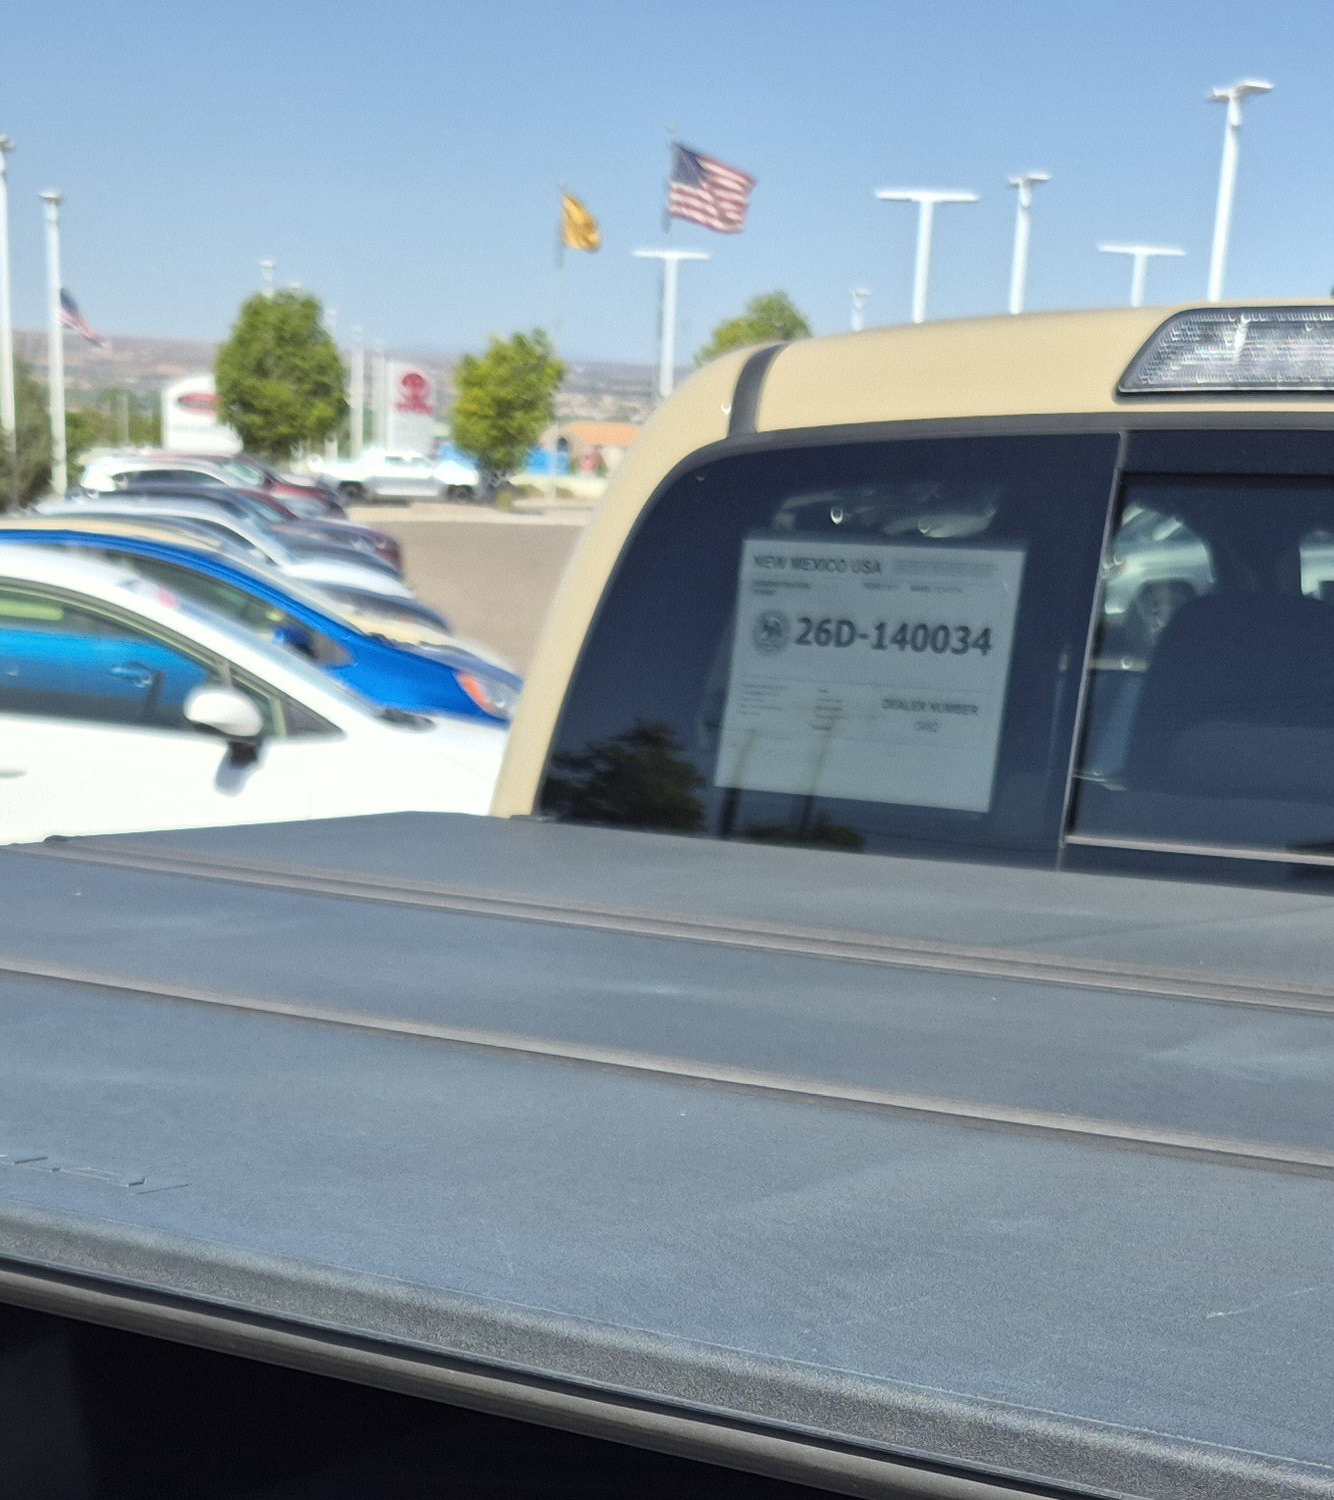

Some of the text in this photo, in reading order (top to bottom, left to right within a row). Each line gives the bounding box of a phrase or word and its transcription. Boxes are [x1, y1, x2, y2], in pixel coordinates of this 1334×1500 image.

[753, 555, 786, 572] NEW
[790, 556, 847, 574] MEXICO
[850, 558, 882, 575] USA
[795, 617, 993, 657] 26D-140034
